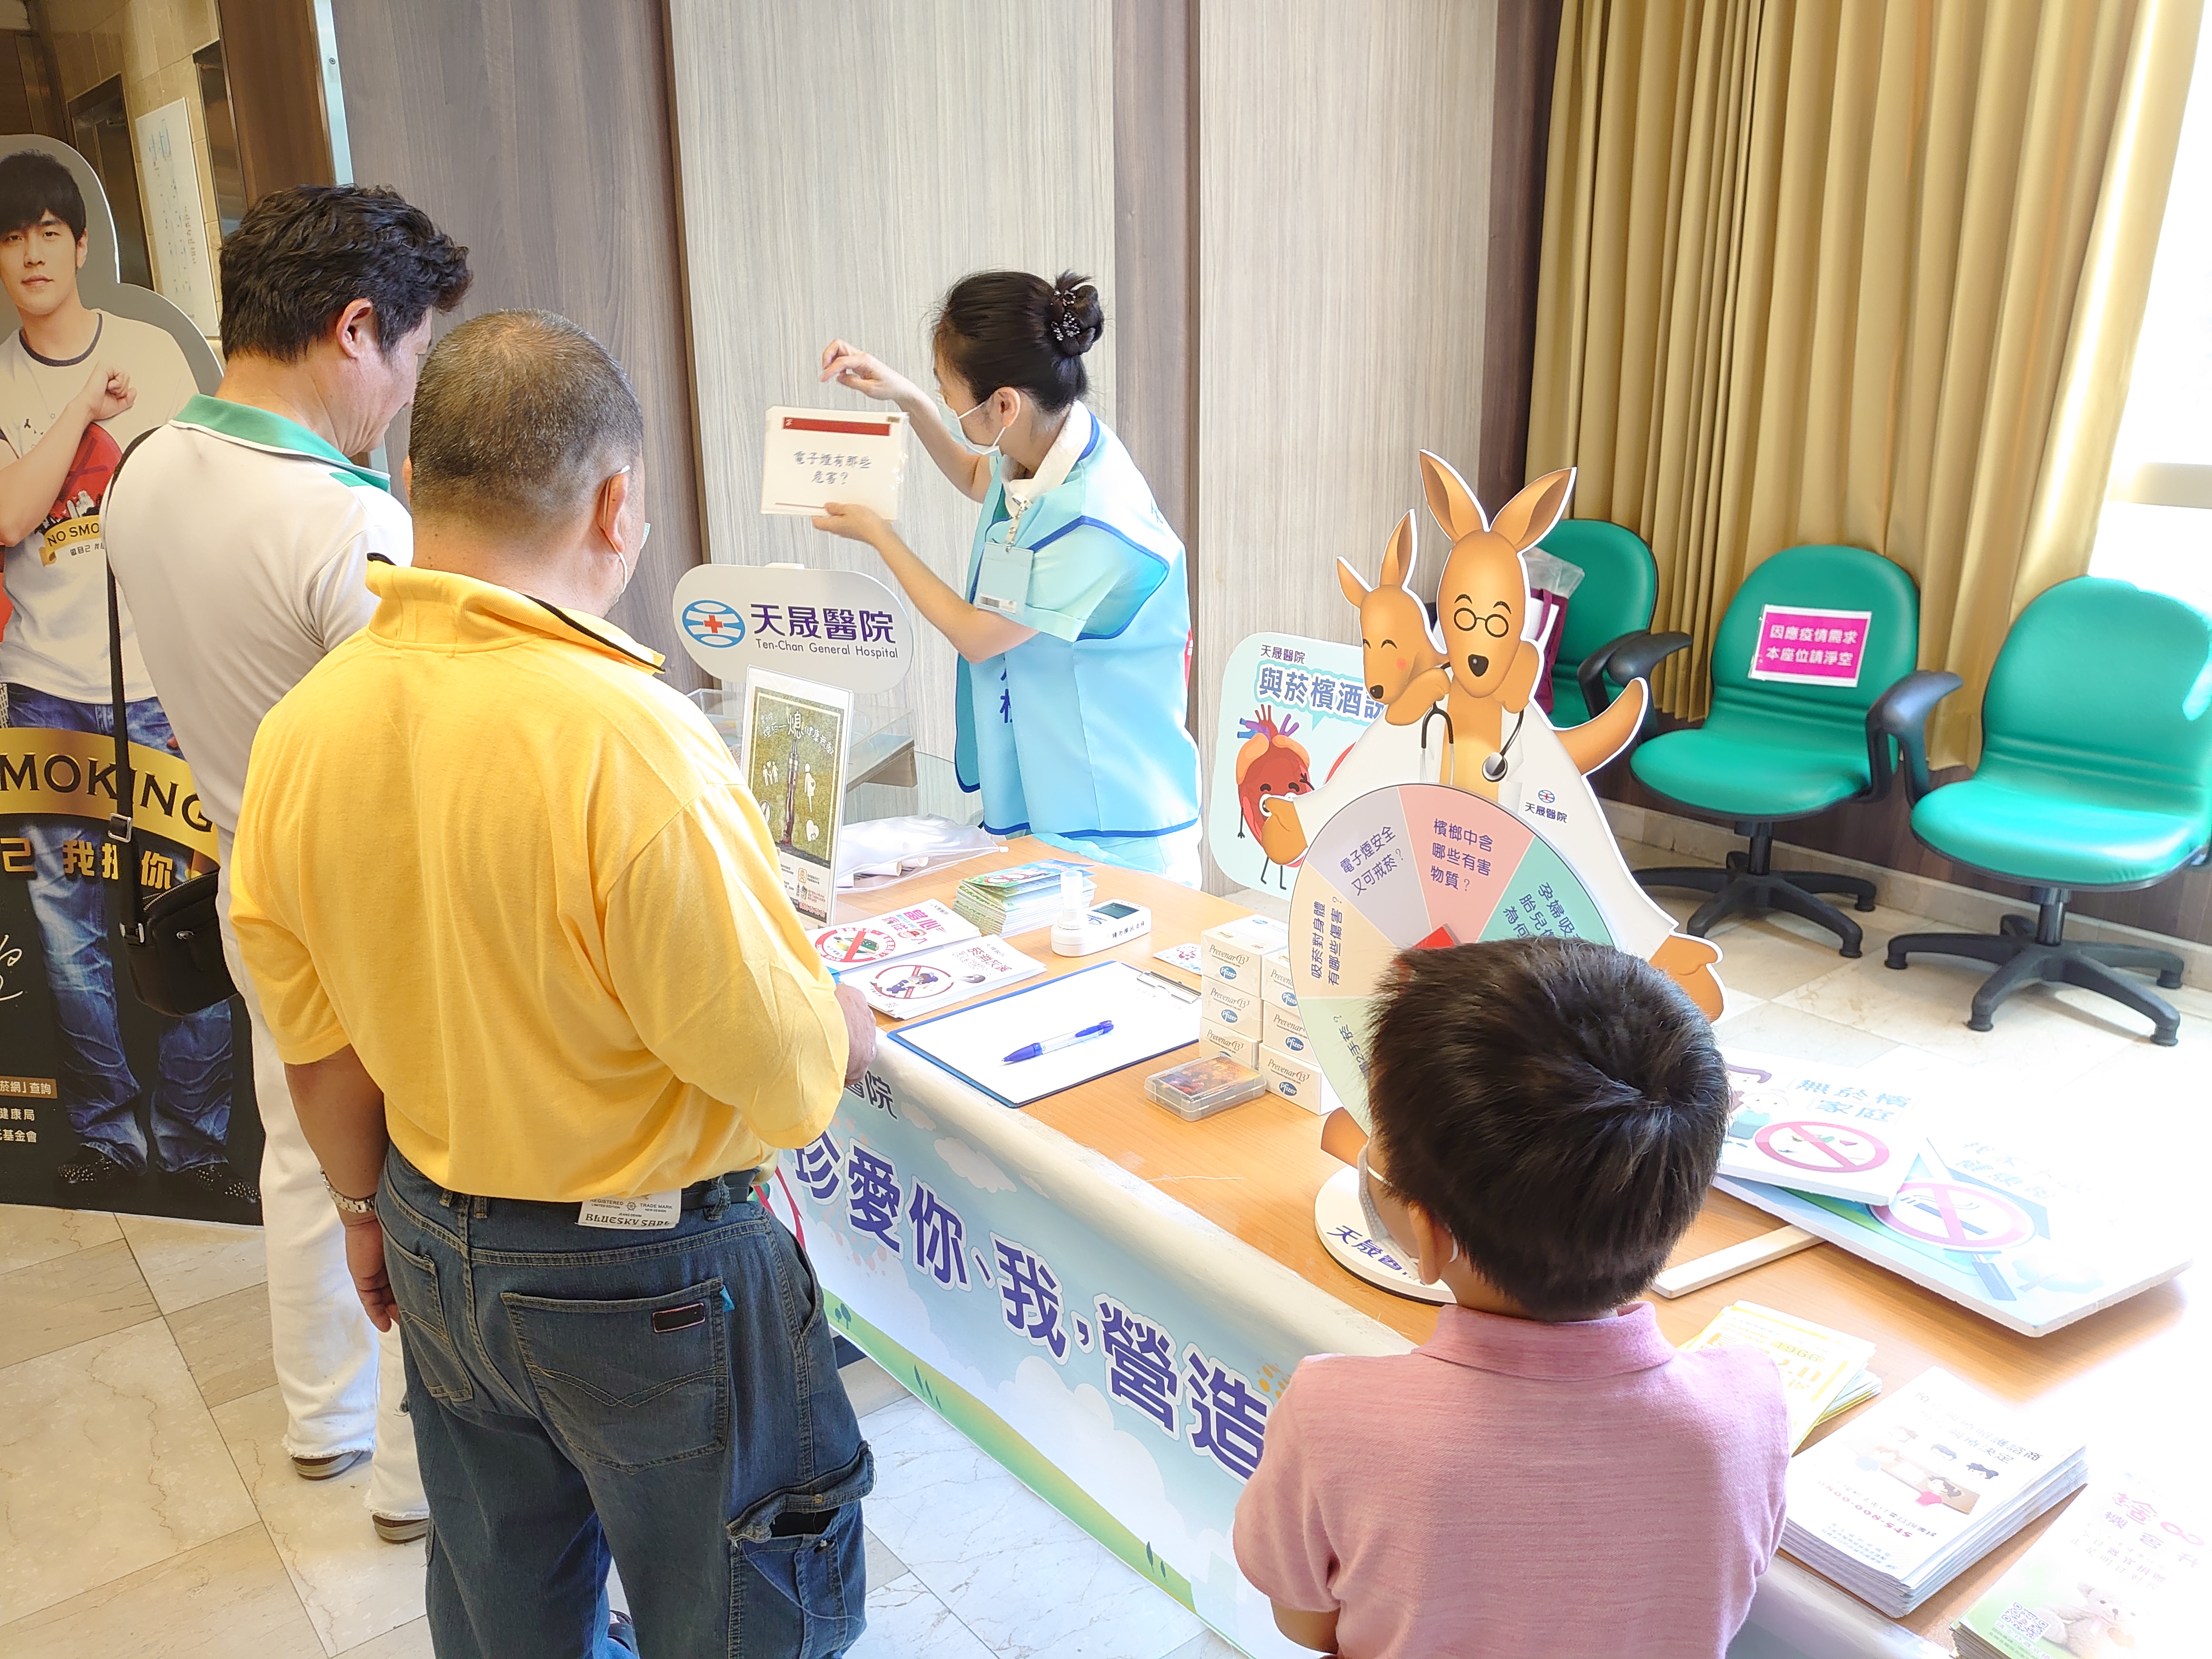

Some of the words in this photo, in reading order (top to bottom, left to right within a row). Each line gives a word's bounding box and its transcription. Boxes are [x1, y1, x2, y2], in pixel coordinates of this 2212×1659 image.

[47, 531, 66, 547] NO
[69, 522, 100, 538] SMO
[750, 603, 897, 644] 天晟醫院
[1769, 624, 1859, 645] 因應疫情需求
[755, 638, 804, 652] Ten-Chan
[809, 642, 850, 656] General
[855, 645, 899, 659] Hospital
[1260, 644, 1306, 665] 天晟醫院
[1765, 645, 1854, 667] 本座位請淨空
[1525, 802, 1568, 823] 天晟醫院
[1433, 817, 1494, 853] 檳榔中含
[1339, 825, 1397, 874] 電子煙安全
[1432, 842, 1491, 877] 哪些有害
[1350, 848, 1404, 896] 又可戒菸？
[1430, 865, 1470, 892] 物質？
[1538, 881, 1582, 939] 孕婦吸
[1311, 900, 1326, 979] 吸菸對身體
[1328, 895, 1344, 986] 有哪些傷害？
[1209, 944, 1237, 962] Prevenar
[1220, 967, 1237, 979] Pfizer
[1210, 988, 1238, 1005] Prevenar
[1222, 1011, 1238, 1022] Pfizer
[1273, 1014, 1304, 1032] Prevenar
[1206, 1029, 1233, 1047] Prevenar
[1286, 1037, 1304, 1050] Pfizer
[1267, 1058, 1296, 1078] Prevenar
[1280, 1082, 1297, 1095] Pfizer
[1815, 1099, 1895, 1122] 家庭
[585, 1213, 640, 1226] BLUESKY
[1776, 1341, 1820, 1363] 1966
